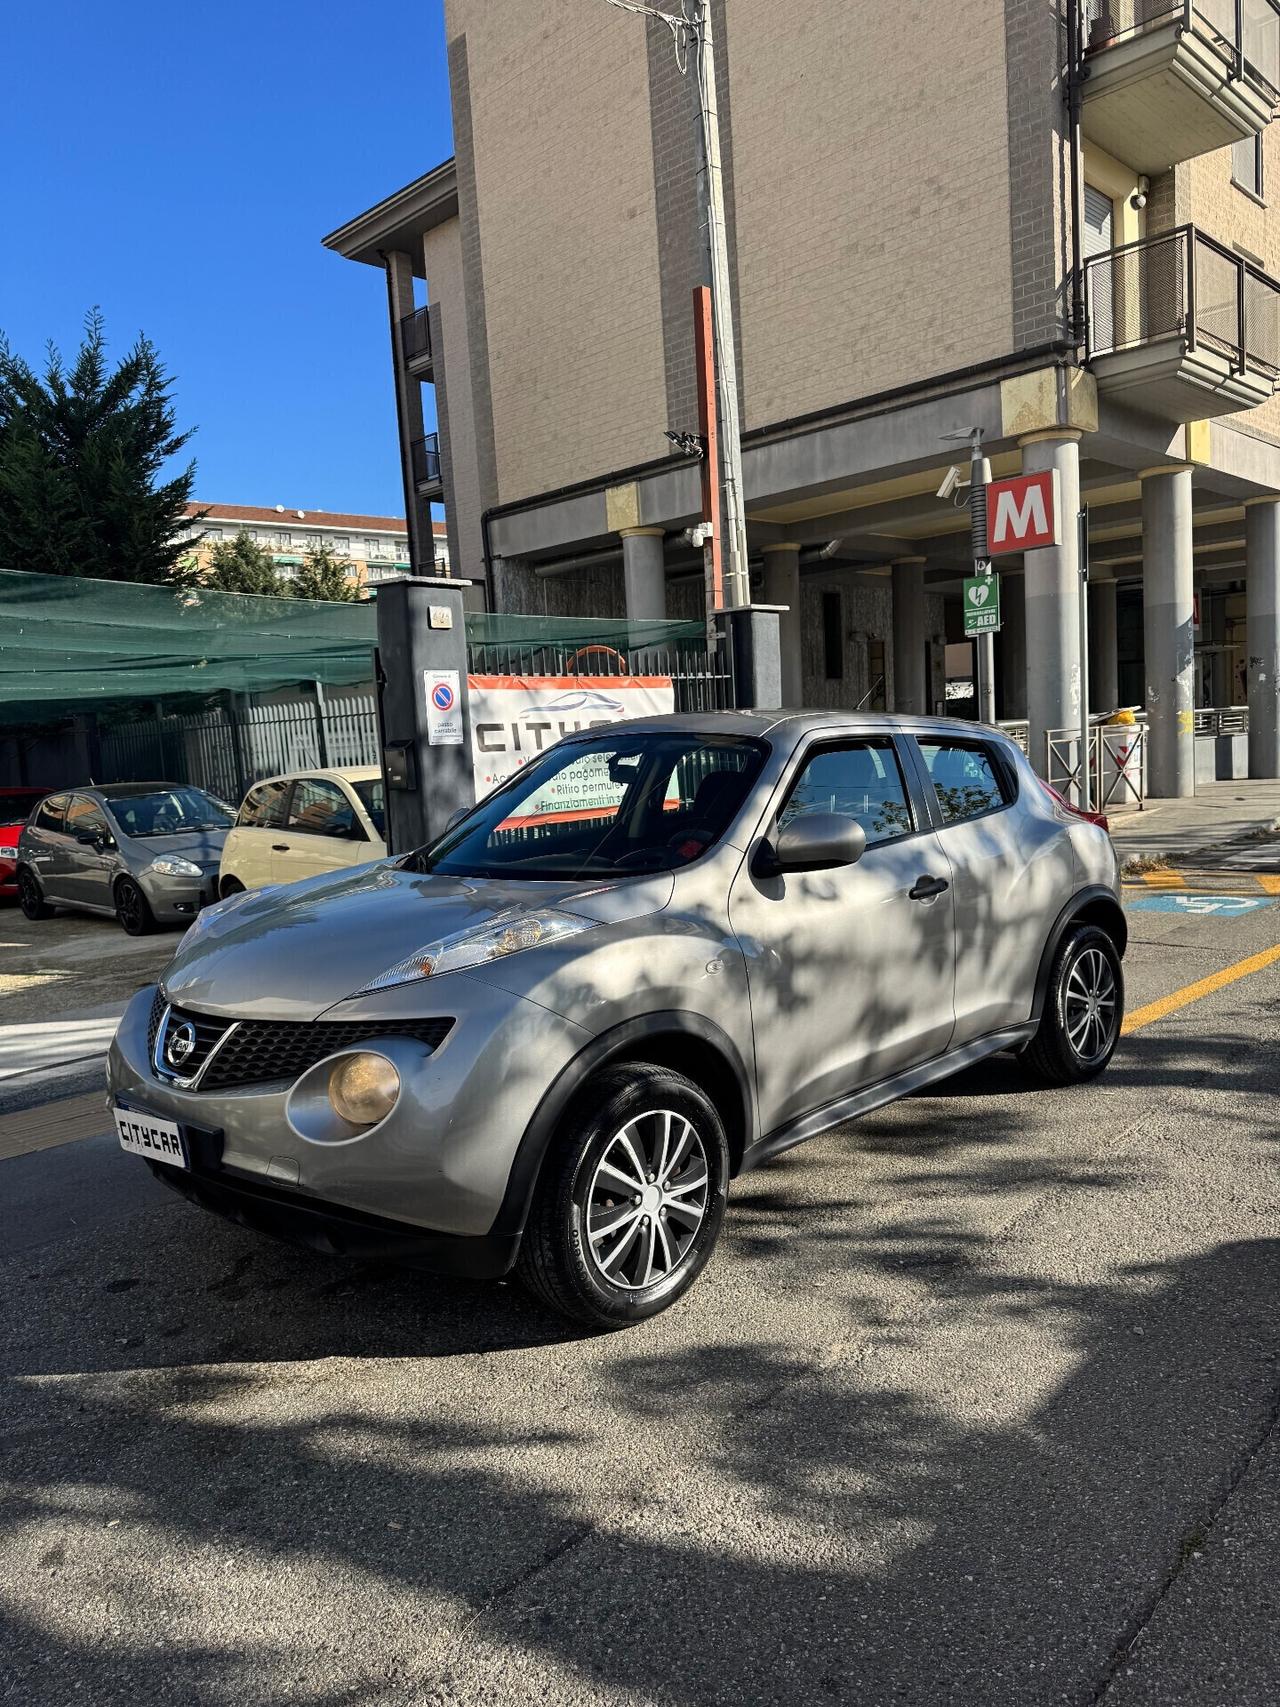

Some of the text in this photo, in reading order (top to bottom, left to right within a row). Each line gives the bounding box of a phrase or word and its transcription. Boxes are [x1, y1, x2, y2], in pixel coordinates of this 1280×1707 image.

[993, 484, 1049, 543] M
[977, 615, 996, 626] AED
[556, 783, 580, 795] Ritiro
[540, 793, 605, 812] Finanziamenti
[119, 1120, 182, 1157] CITYCAR
